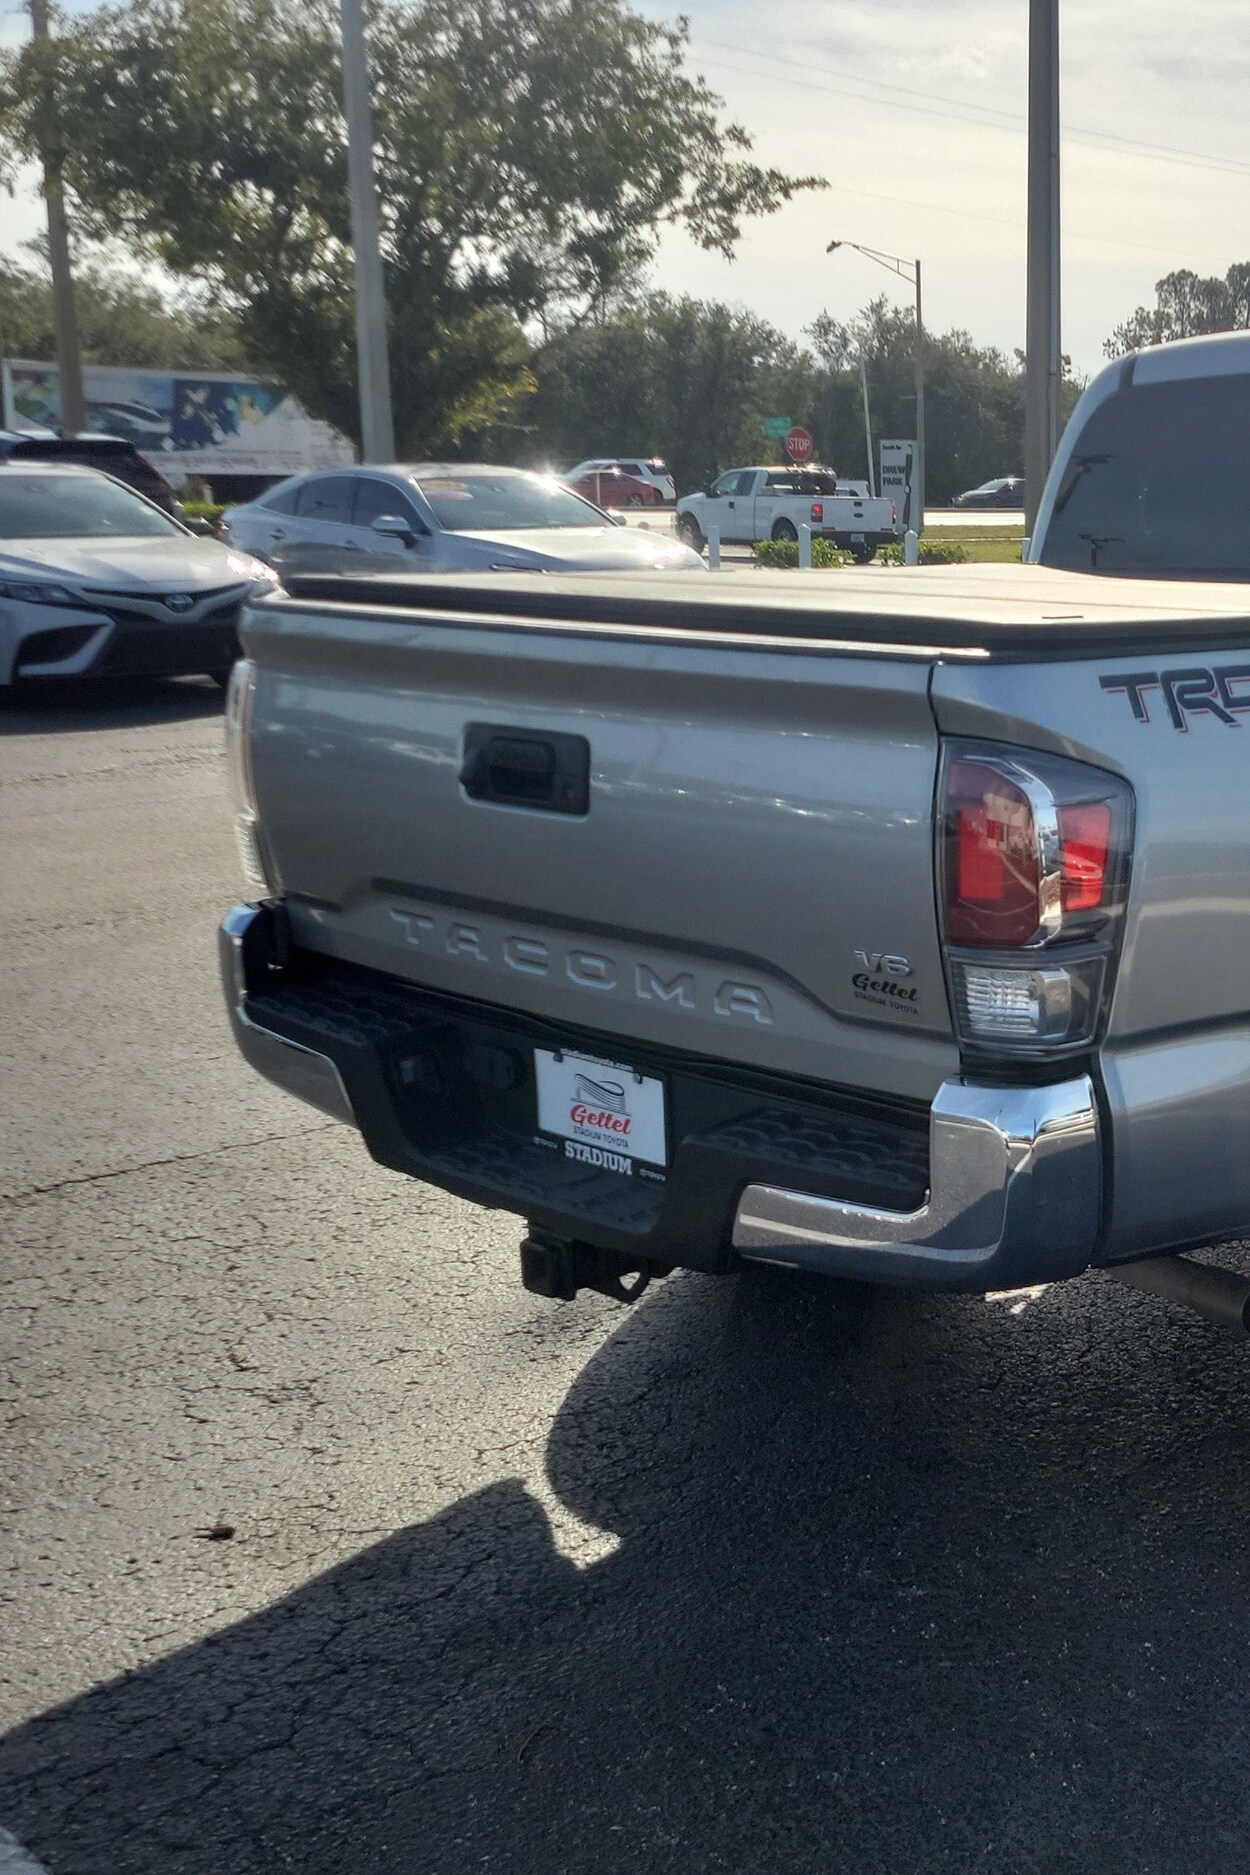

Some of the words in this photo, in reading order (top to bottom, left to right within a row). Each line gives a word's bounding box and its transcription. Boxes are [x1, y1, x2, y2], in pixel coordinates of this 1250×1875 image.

[788, 437, 811, 451] STOP
[882, 477, 904, 486] PARK
[389, 908, 774, 1026] TACOMA
[854, 949, 913, 977] V6
[851, 973, 918, 1002] Gettel
[854, 990, 887, 1006] STADIUM
[889, 1000, 919, 1015] TOYOTA
[569, 1104, 632, 1135] Gettel
[573, 1125, 602, 1140] STADIUM
[602, 1133, 630, 1148] TOYOTA
[564, 1140, 633, 1176] STADIUM
